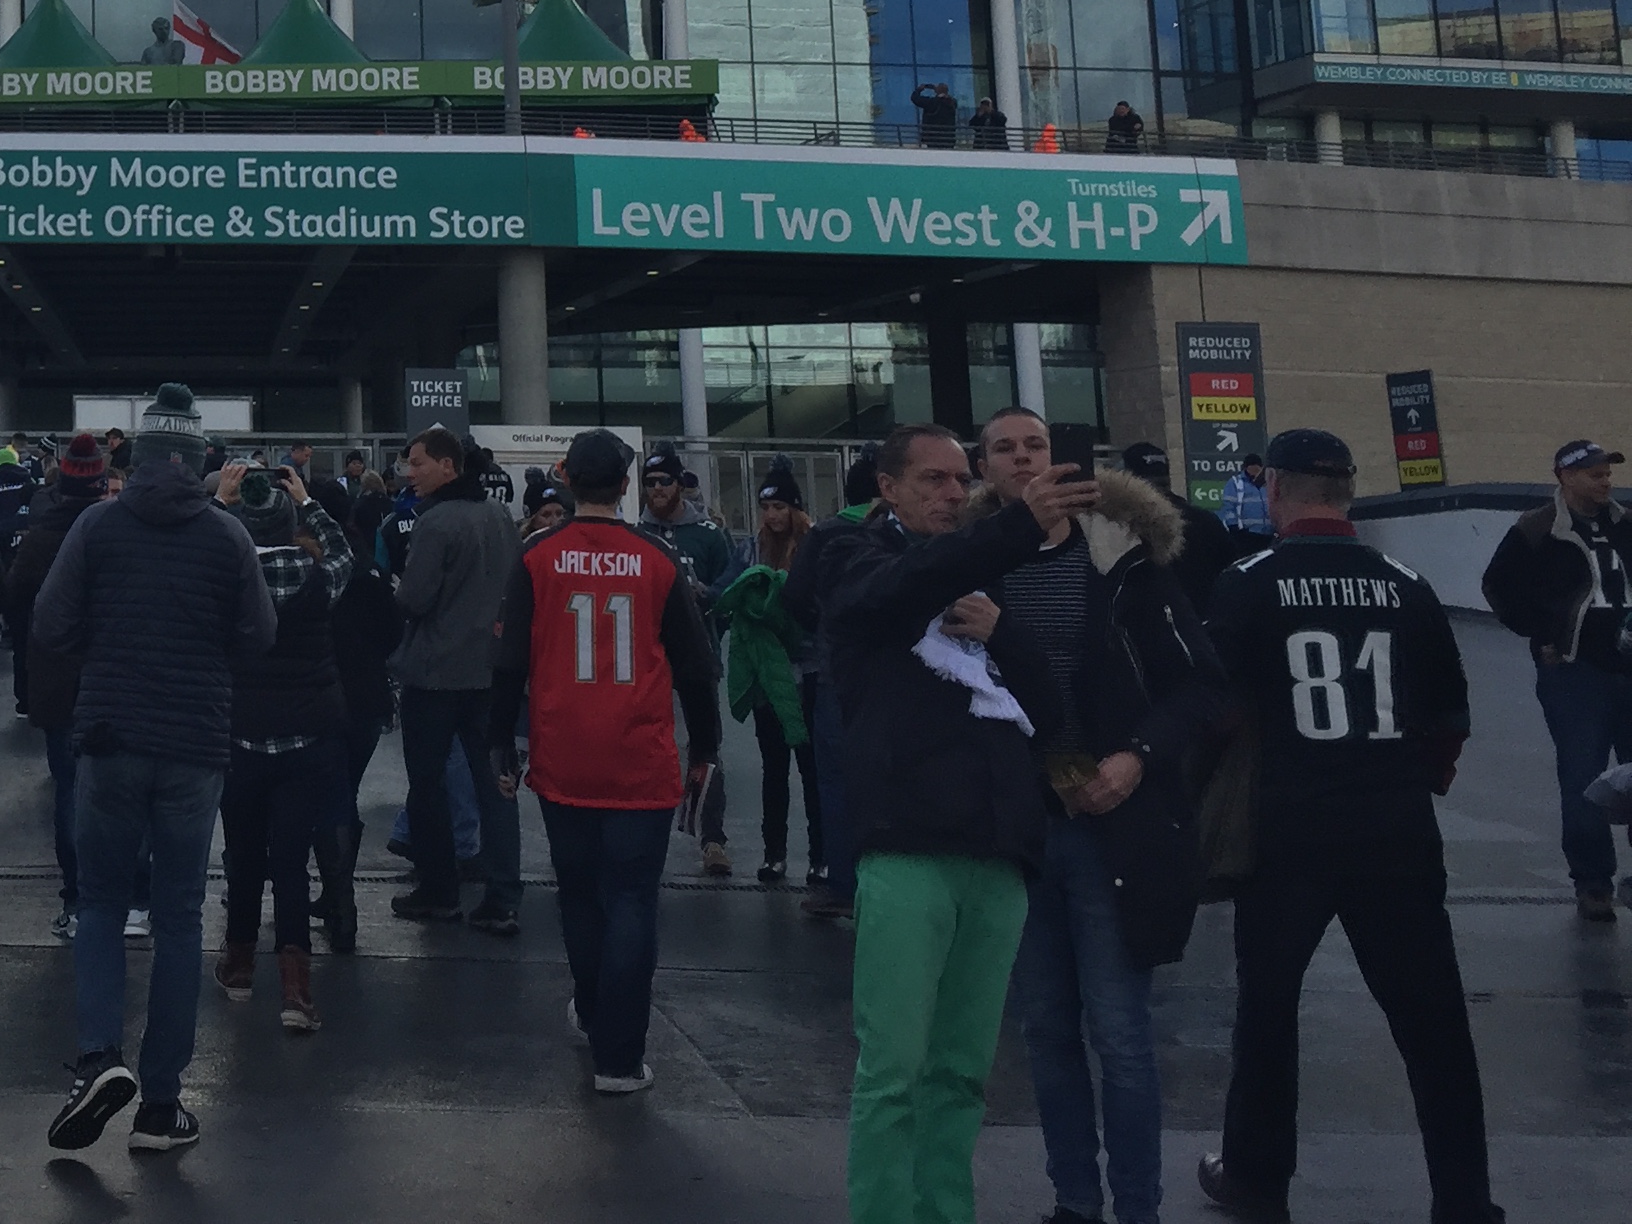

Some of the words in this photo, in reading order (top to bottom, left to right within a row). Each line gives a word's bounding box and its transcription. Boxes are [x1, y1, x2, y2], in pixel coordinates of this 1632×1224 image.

[47, 71, 153, 95] MOORE
[205, 69, 305, 94] BOBBY
[312, 66, 420, 92] MOORE
[474, 65, 574, 90] BOBBY
[582, 65, 692, 89] MOORE
[1316, 65, 1384, 81] WEMBLEY
[1386, 68, 1469, 82] CONNECTED
[1471, 72, 1490, 83] BY
[1492, 72, 1507, 84] EE
[1524, 74, 1588, 88] WEMBLEY
[110, 156, 225, 188] Moore
[238, 158, 398, 189] Entrance
[1067, 178, 1158, 199] Turnstiles
[104, 203, 215, 238] Office
[225, 206, 254, 237] &
[264, 204, 416, 239] Stadium
[430, 208, 525, 239] Store
[591, 188, 724, 239] Level
[741, 192, 853, 243] Two
[868, 197, 1001, 247] West
[1013, 200, 1056, 248] &
[1068, 202, 1159, 251] H-P
[1189, 337, 1250, 348] REDUCED
[1189, 349, 1252, 360] MOBILITY
[411, 380, 463, 393] TICKET
[1211, 379, 1239, 390] RED
[411, 395, 462, 408] OFFICE
[1197, 403, 1250, 414] YELLOW
[512, 434, 543, 443] Official
[545, 435, 574, 445] Progra
[1408, 438, 1427, 451] RED
[1192, 460, 1211, 472] TO
[1216, 460, 1244, 472] GAT
[1403, 465, 1439, 477] YELLOW
[554, 550, 641, 577] JACKSON
[1276, 578, 1400, 608] MATTHEWS
[565, 591, 635, 685] 11
[1286, 630, 1403, 740] 81
